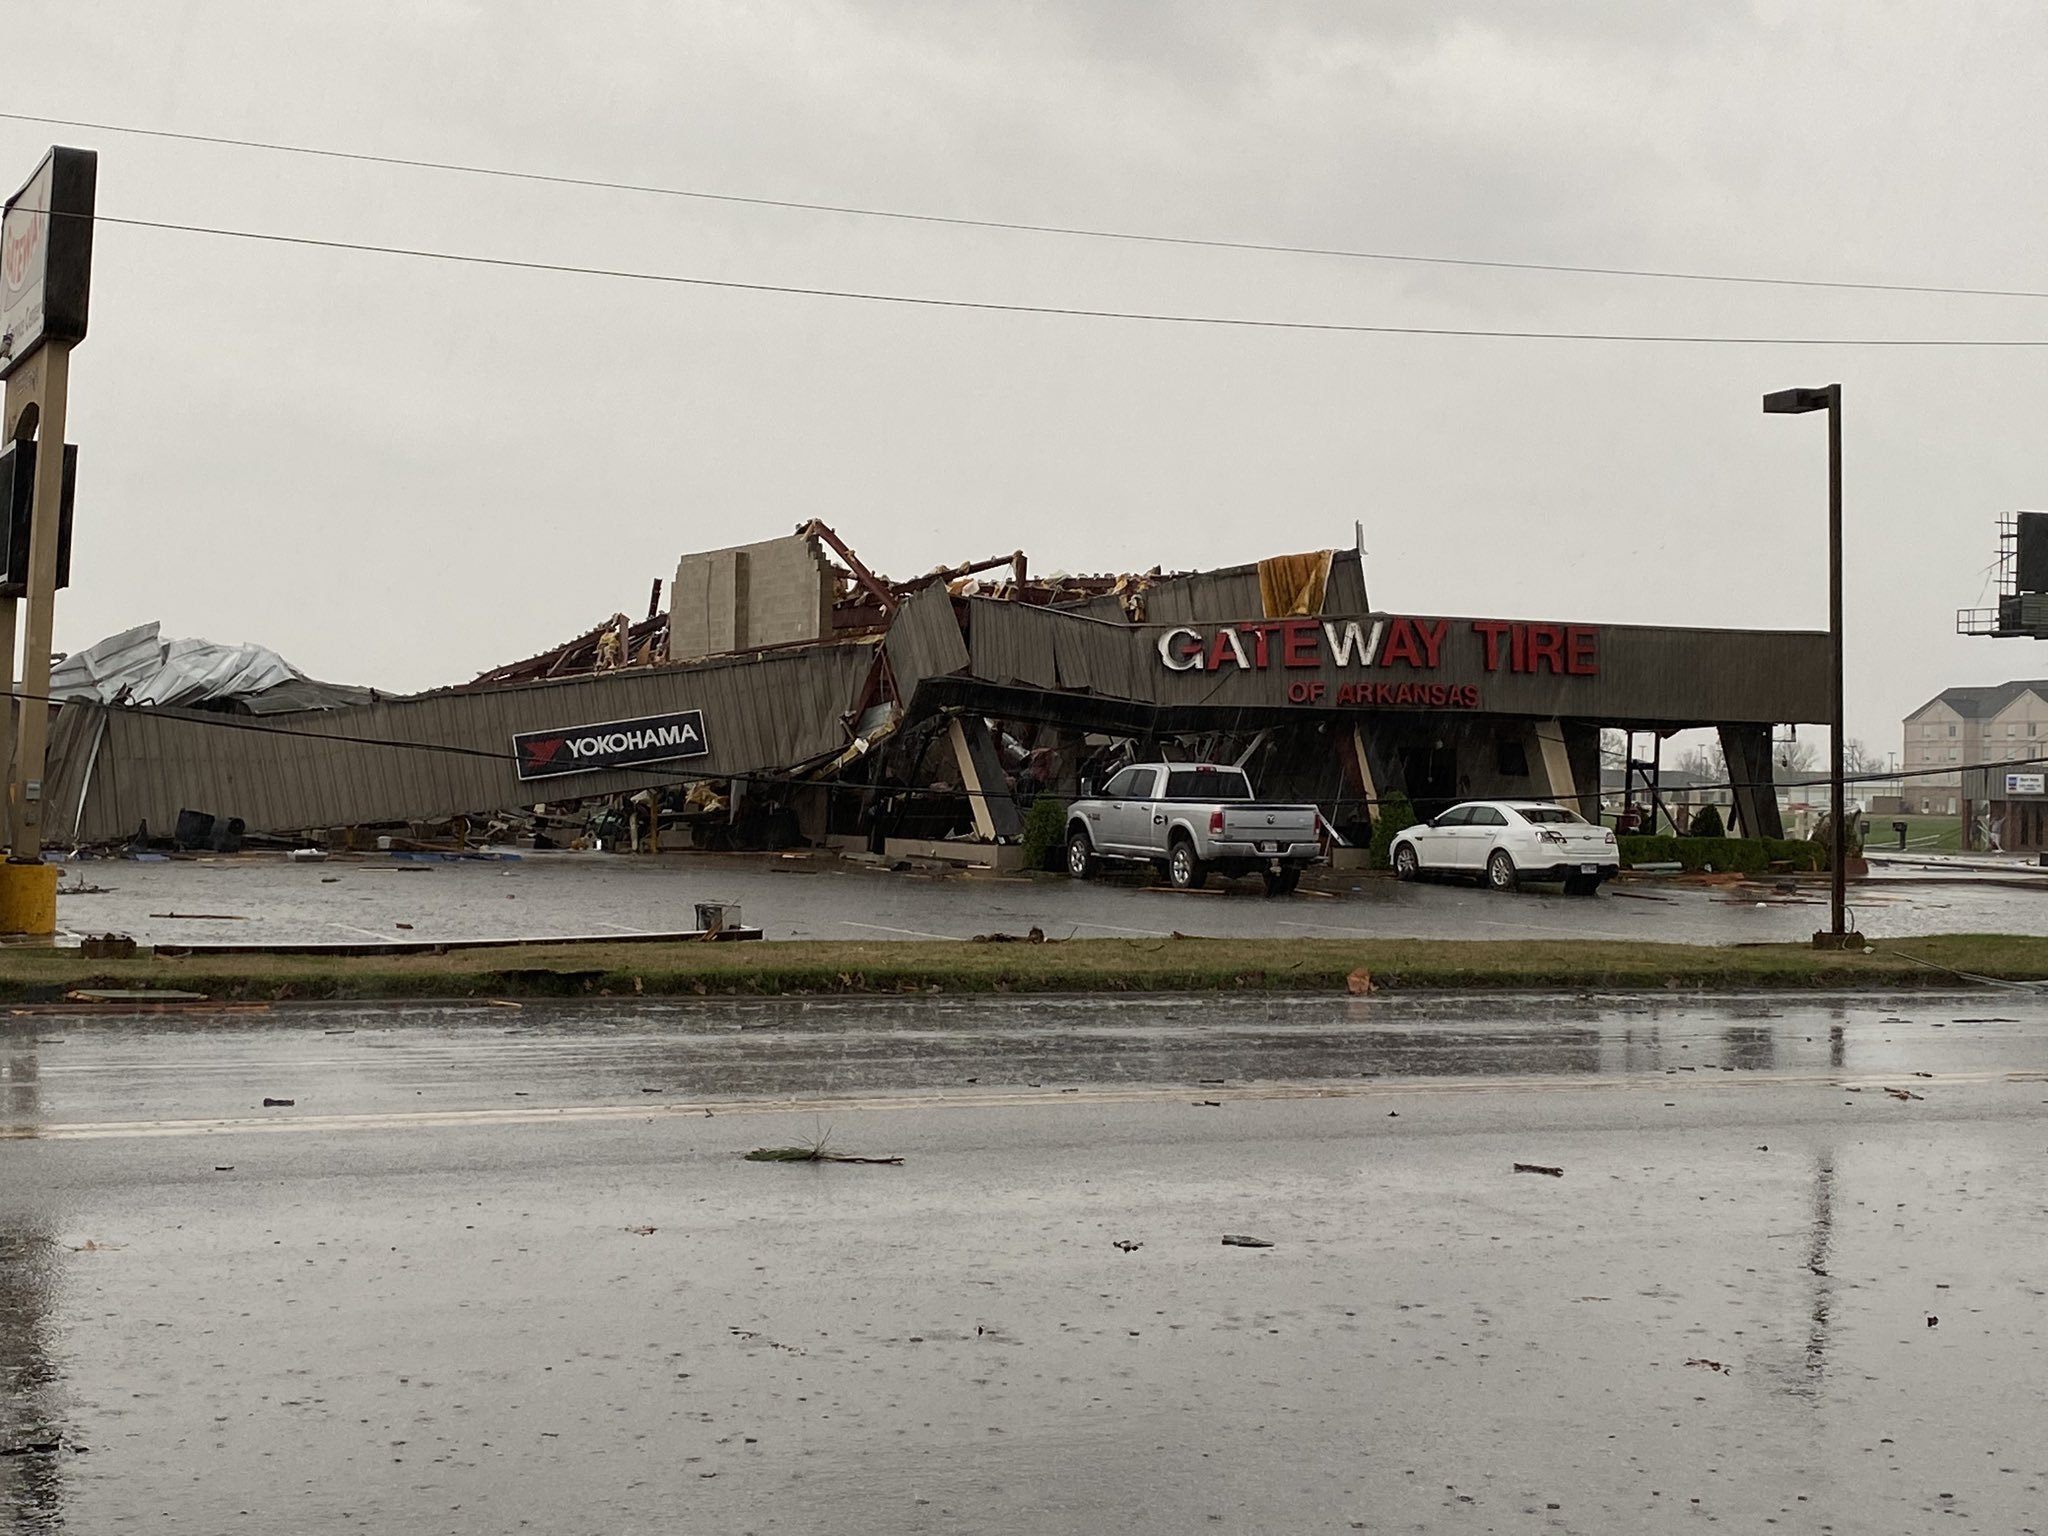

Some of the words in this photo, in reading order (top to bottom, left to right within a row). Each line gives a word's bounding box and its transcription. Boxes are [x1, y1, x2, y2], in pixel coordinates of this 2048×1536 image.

[1158, 618, 1447, 671] GATEWAY
[1473, 622, 1599, 675] TIRE
[1288, 682, 1325, 704] OF
[1336, 682, 1479, 707] ARKANSAS
[566, 724, 699, 759] YOKOHAMA
